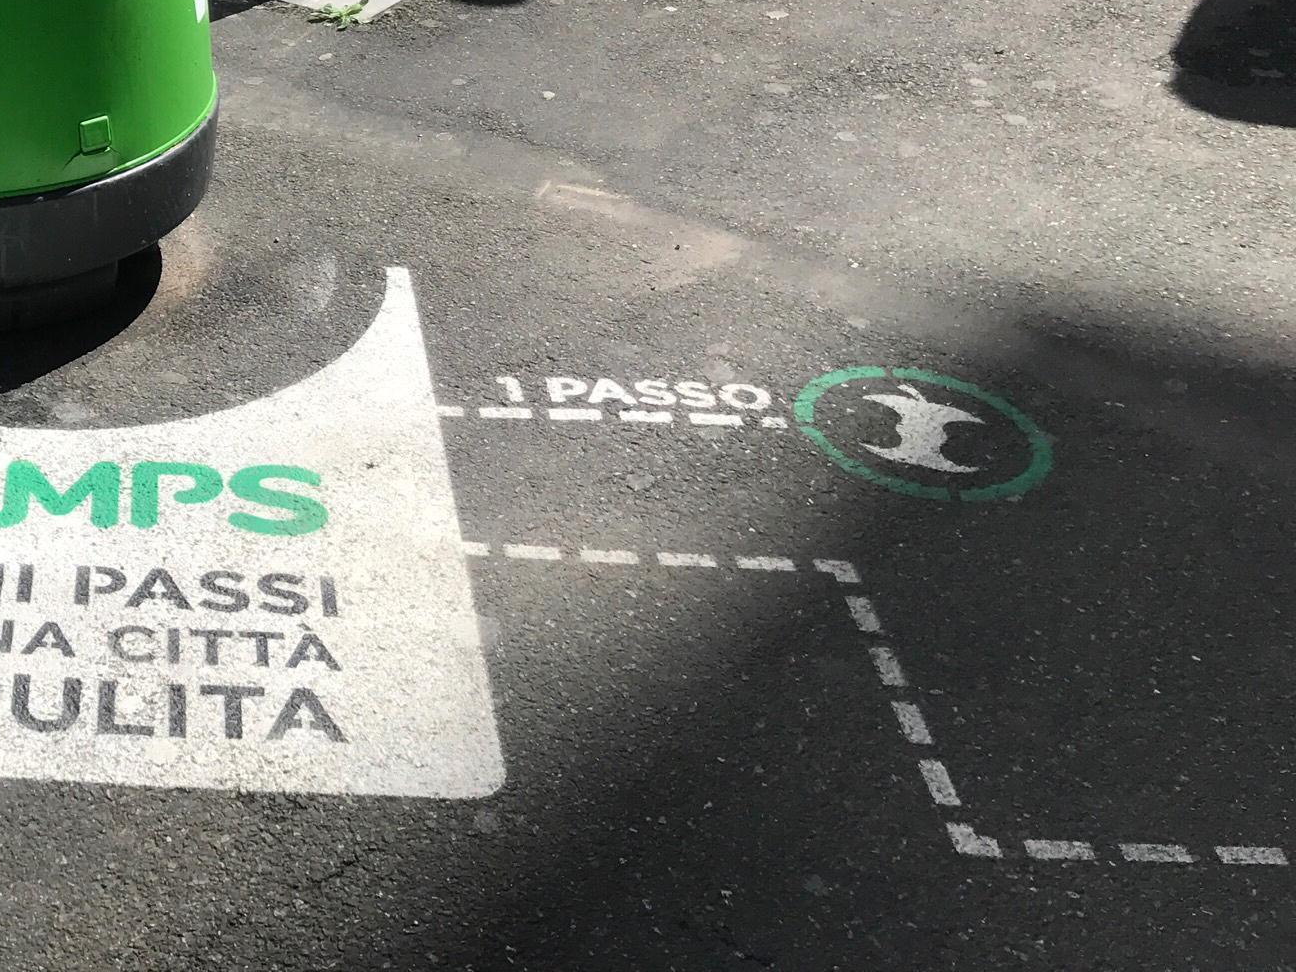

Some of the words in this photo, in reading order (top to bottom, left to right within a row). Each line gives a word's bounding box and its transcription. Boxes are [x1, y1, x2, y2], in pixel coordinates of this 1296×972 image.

[496, 377, 525, 403] 1
[546, 377, 773, 411] PASSO
[74, 565, 339, 618] PASSI
[106, 622, 343, 671] CITTÀ
